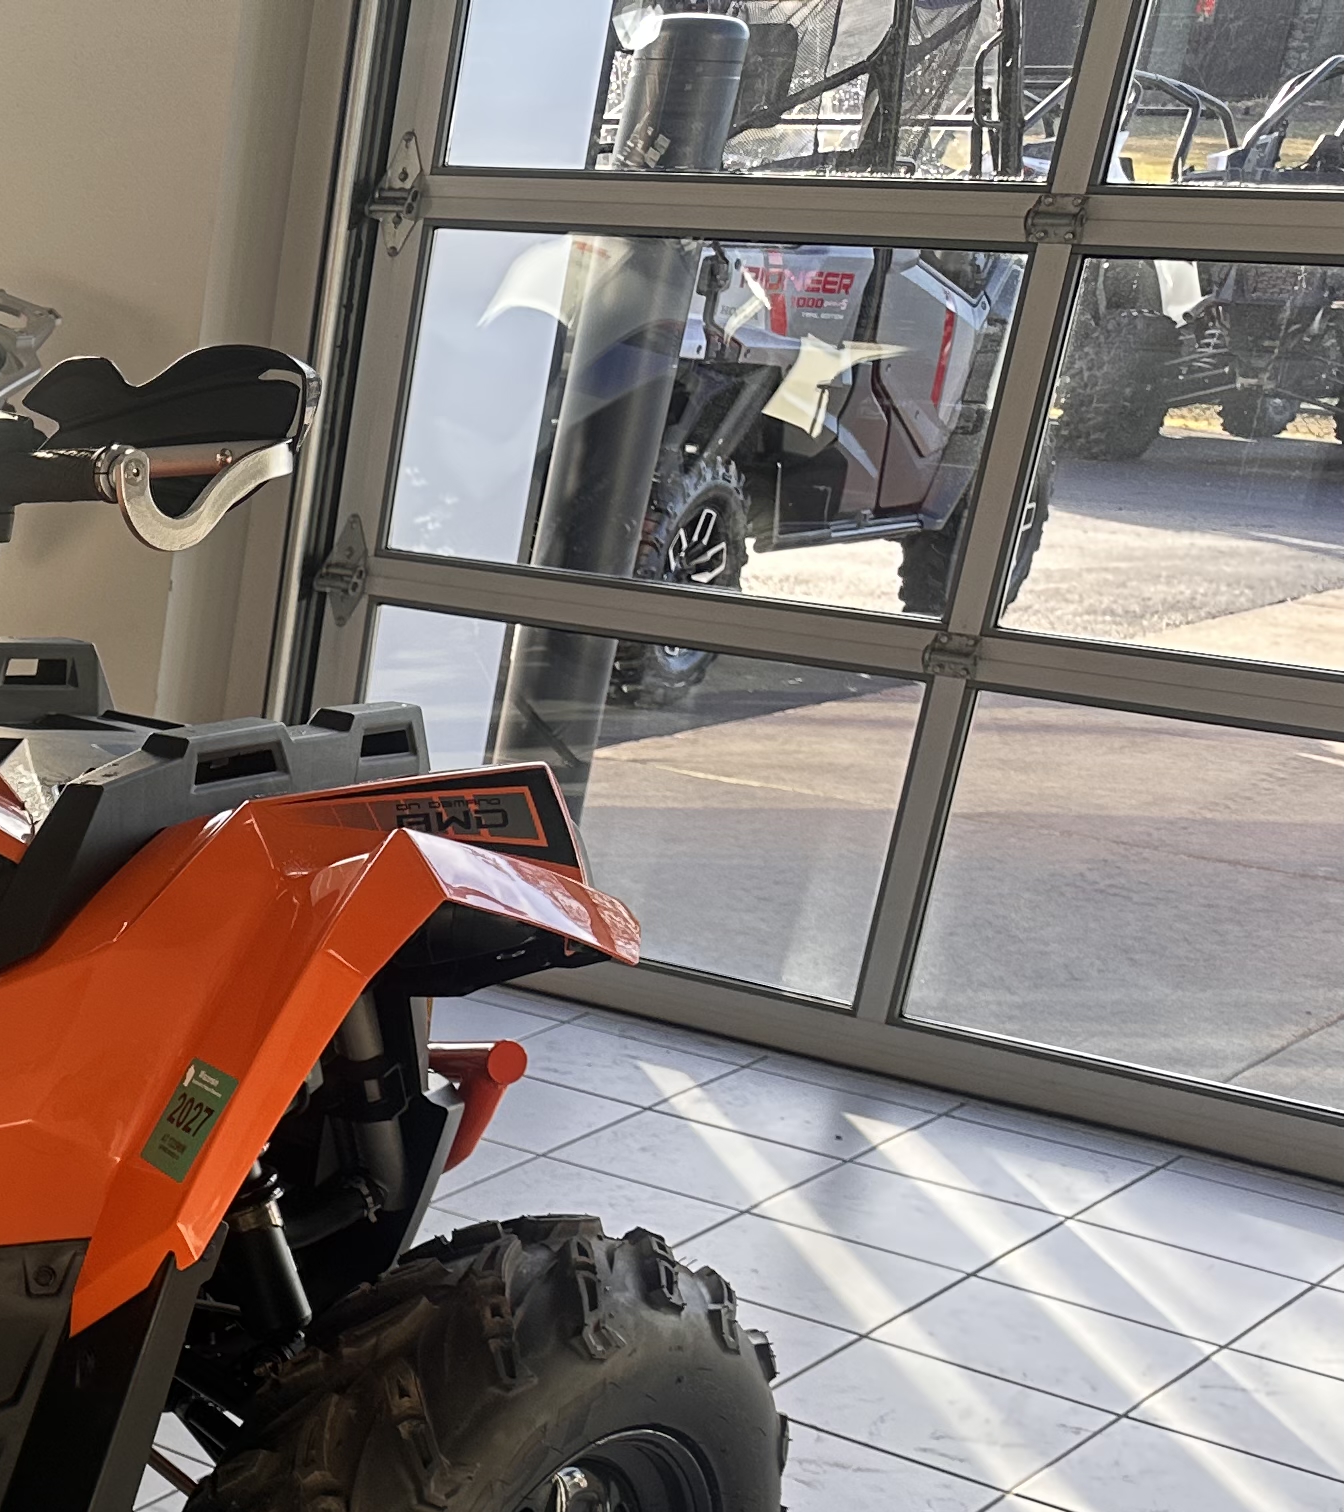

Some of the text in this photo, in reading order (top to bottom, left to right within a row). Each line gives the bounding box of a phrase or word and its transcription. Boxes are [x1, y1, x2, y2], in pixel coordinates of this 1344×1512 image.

[739, 265, 855, 295] PIONEER
[720, 304, 759, 321] HOA
[396, 808, 509, 832] AWD
[166, 1092, 216, 1138] 2027
